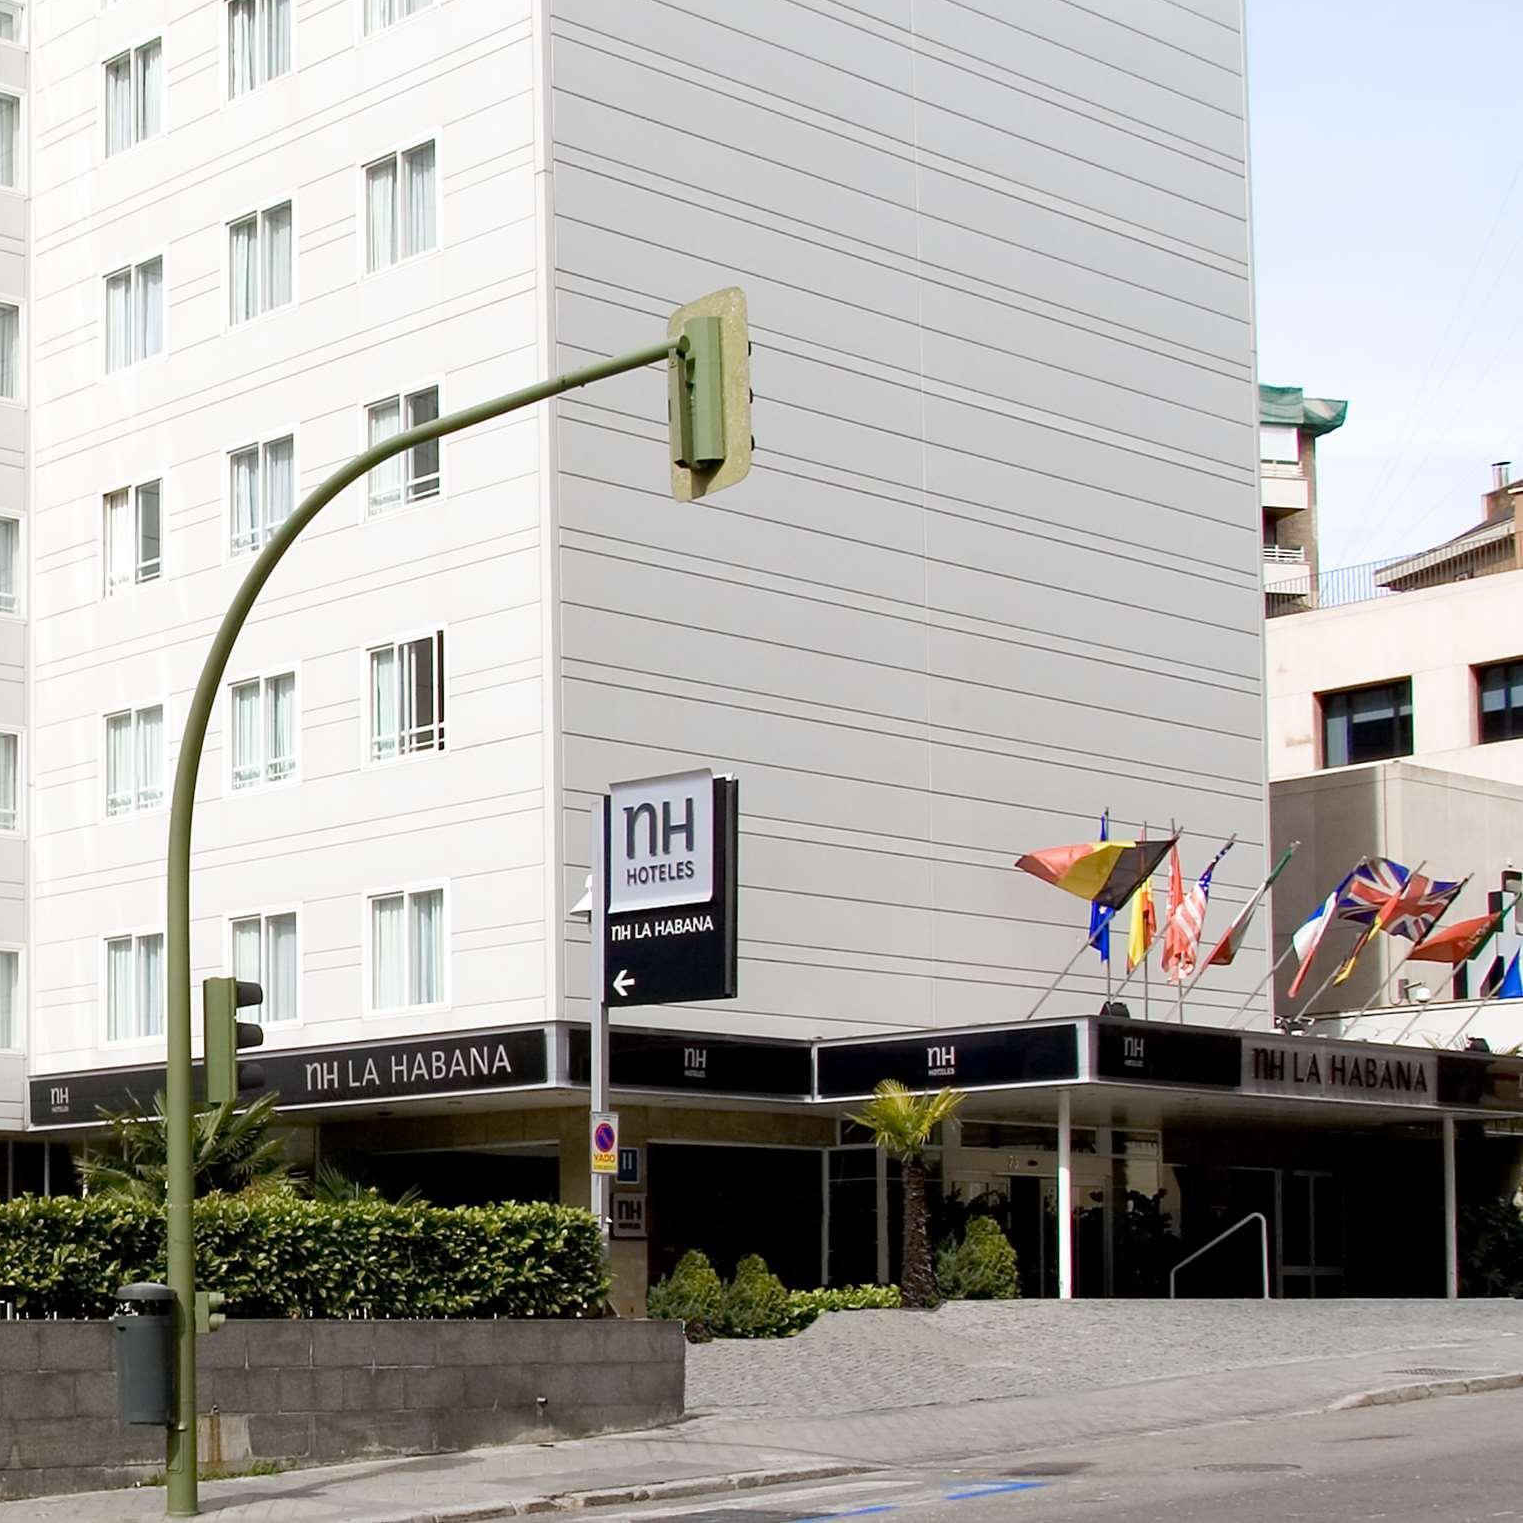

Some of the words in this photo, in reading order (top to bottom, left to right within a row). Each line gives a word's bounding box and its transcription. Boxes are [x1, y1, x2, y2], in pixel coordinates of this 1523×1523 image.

[627, 860, 694, 886] HOTELES
[634, 922, 652, 939] LA
[654, 915, 714, 937] HABANA
[349, 1058, 380, 1087] LA
[391, 1044, 512, 1083] HABANA
[1293, 1052, 1322, 1085] LA
[1329, 1054, 1428, 1092] HABANA
